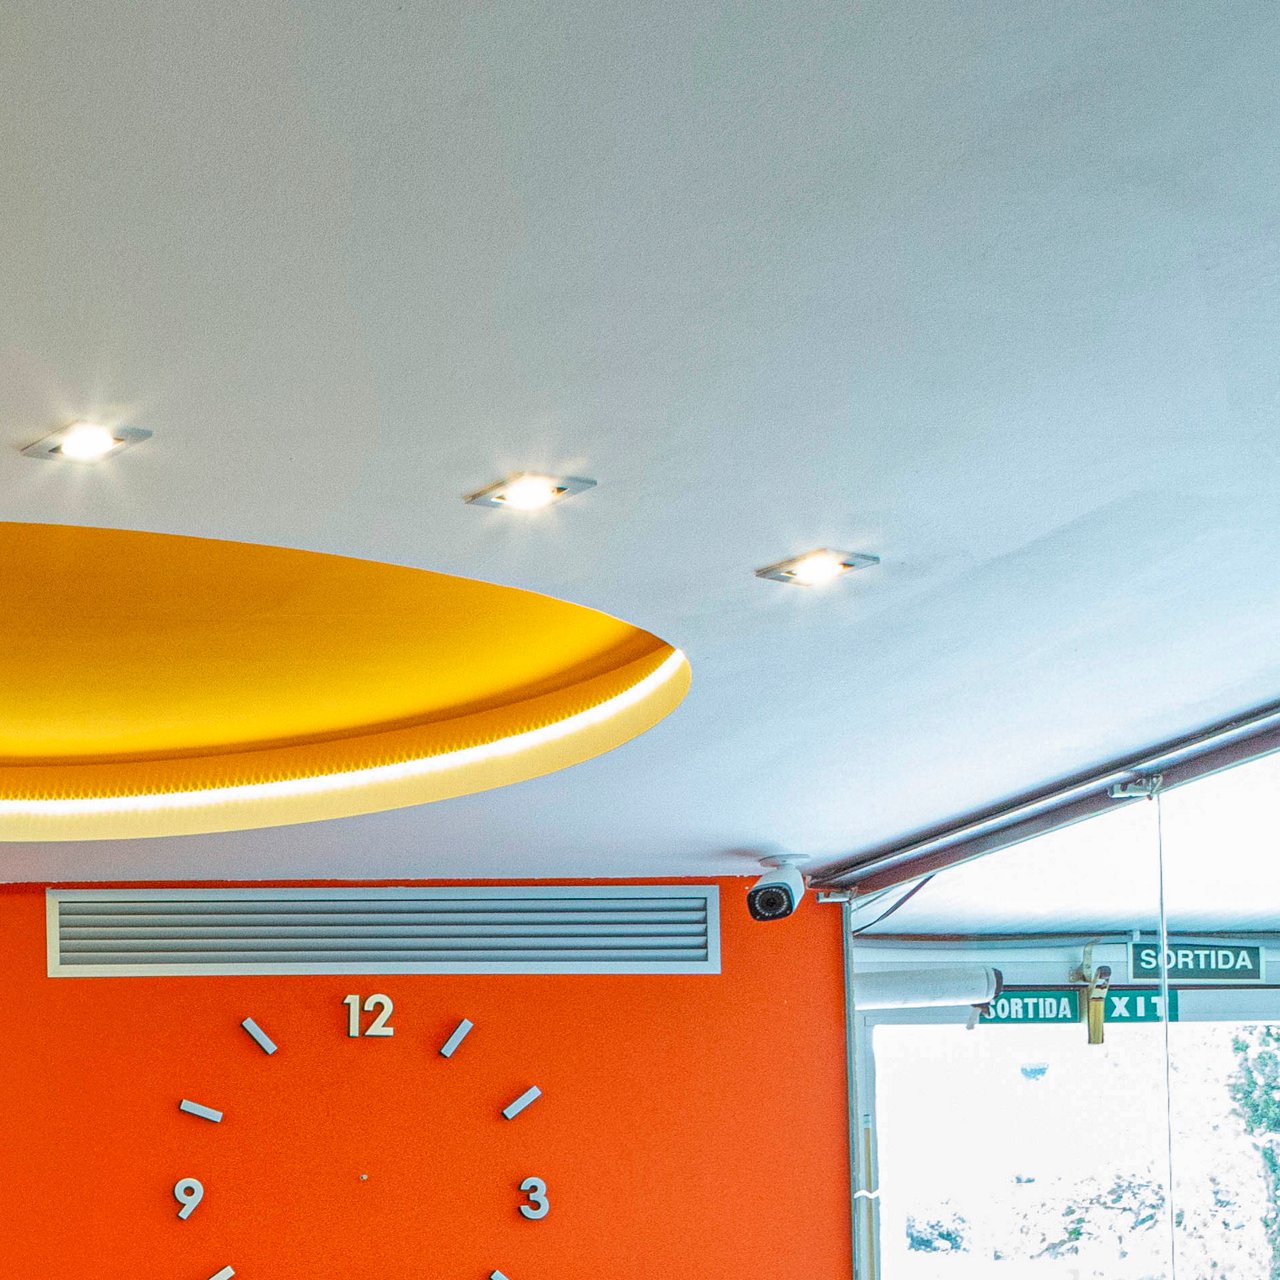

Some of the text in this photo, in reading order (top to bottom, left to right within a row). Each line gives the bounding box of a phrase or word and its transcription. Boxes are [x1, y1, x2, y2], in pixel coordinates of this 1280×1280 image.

[1140, 950, 1254, 969] SORTIDA
[343, 993, 394, 1037] 12
[984, 996, 1170, 1019] SORTIDA XIT
[174, 1177, 205, 1220] 9
[519, 1176, 550, 1220] 3
